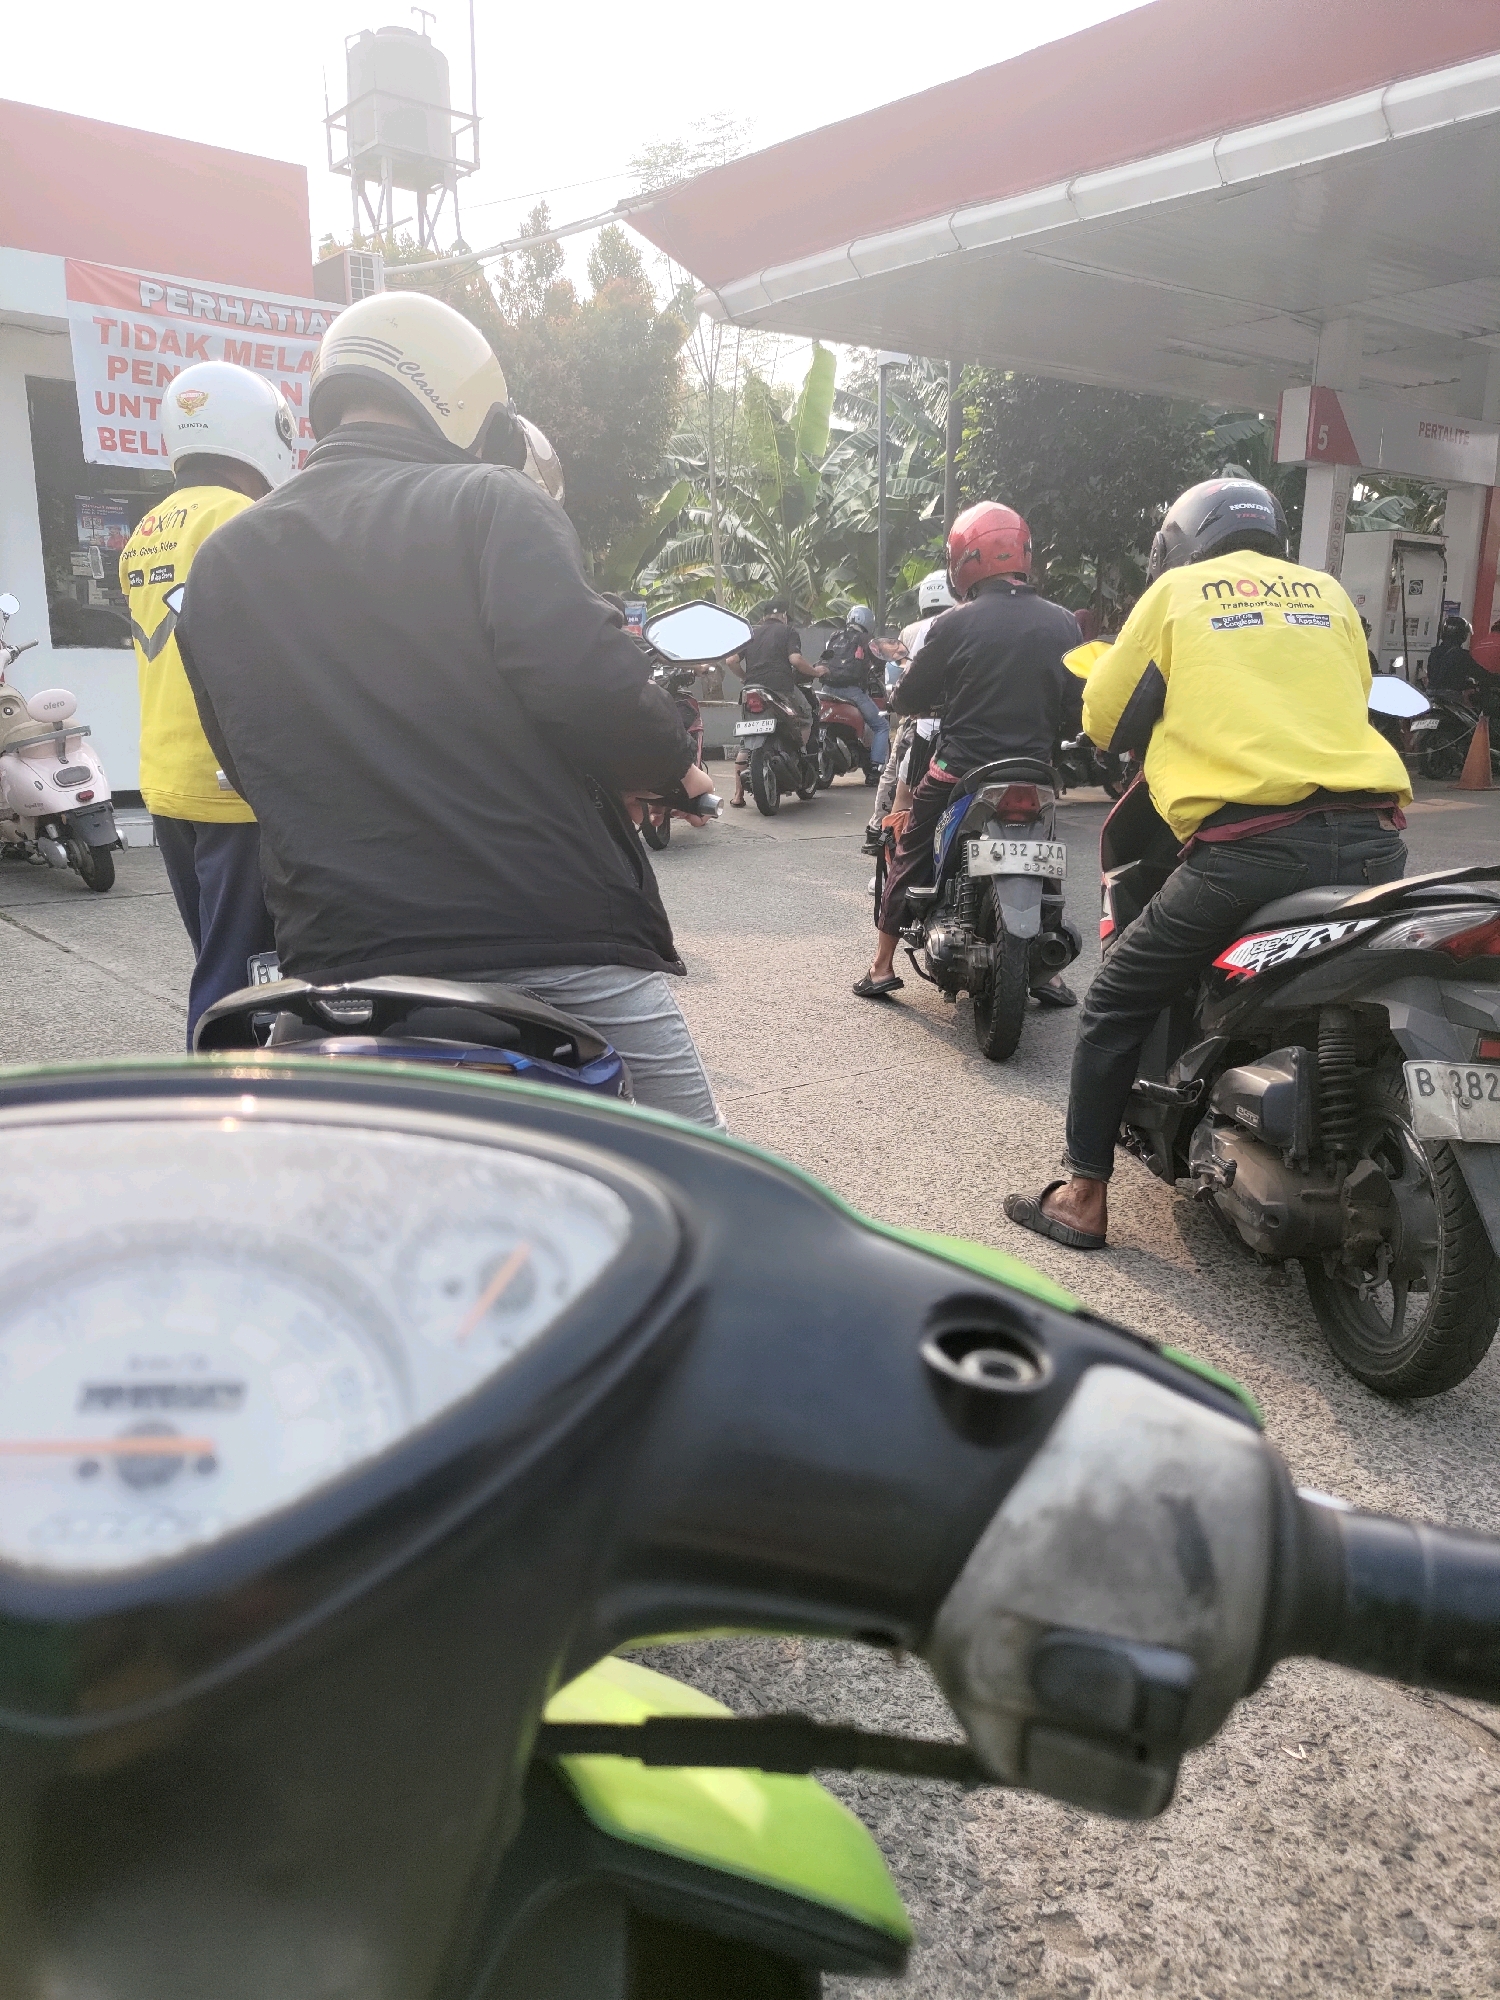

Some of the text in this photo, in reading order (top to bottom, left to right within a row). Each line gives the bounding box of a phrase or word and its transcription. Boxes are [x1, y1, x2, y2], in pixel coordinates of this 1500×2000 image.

[139, 280, 342, 337] PERHATIA
[92, 316, 212, 361] TIDAK
[397, 361, 451, 416] Classic
[178, 422, 209, 430] HONDA
[1317, 424, 1329, 450] 5
[1418, 421, 1470, 446] PERTALITE
[1229, 503, 1272, 514] HONDA
[1201, 575, 1321, 600] maxim
[1220, 600, 1282, 611] Transportasi
[43, 701, 65, 711] ofero
[971, 843, 980, 858] B
[989, 842, 1028, 858] 4132
[1414, 1067, 1500, 1101] B 382
